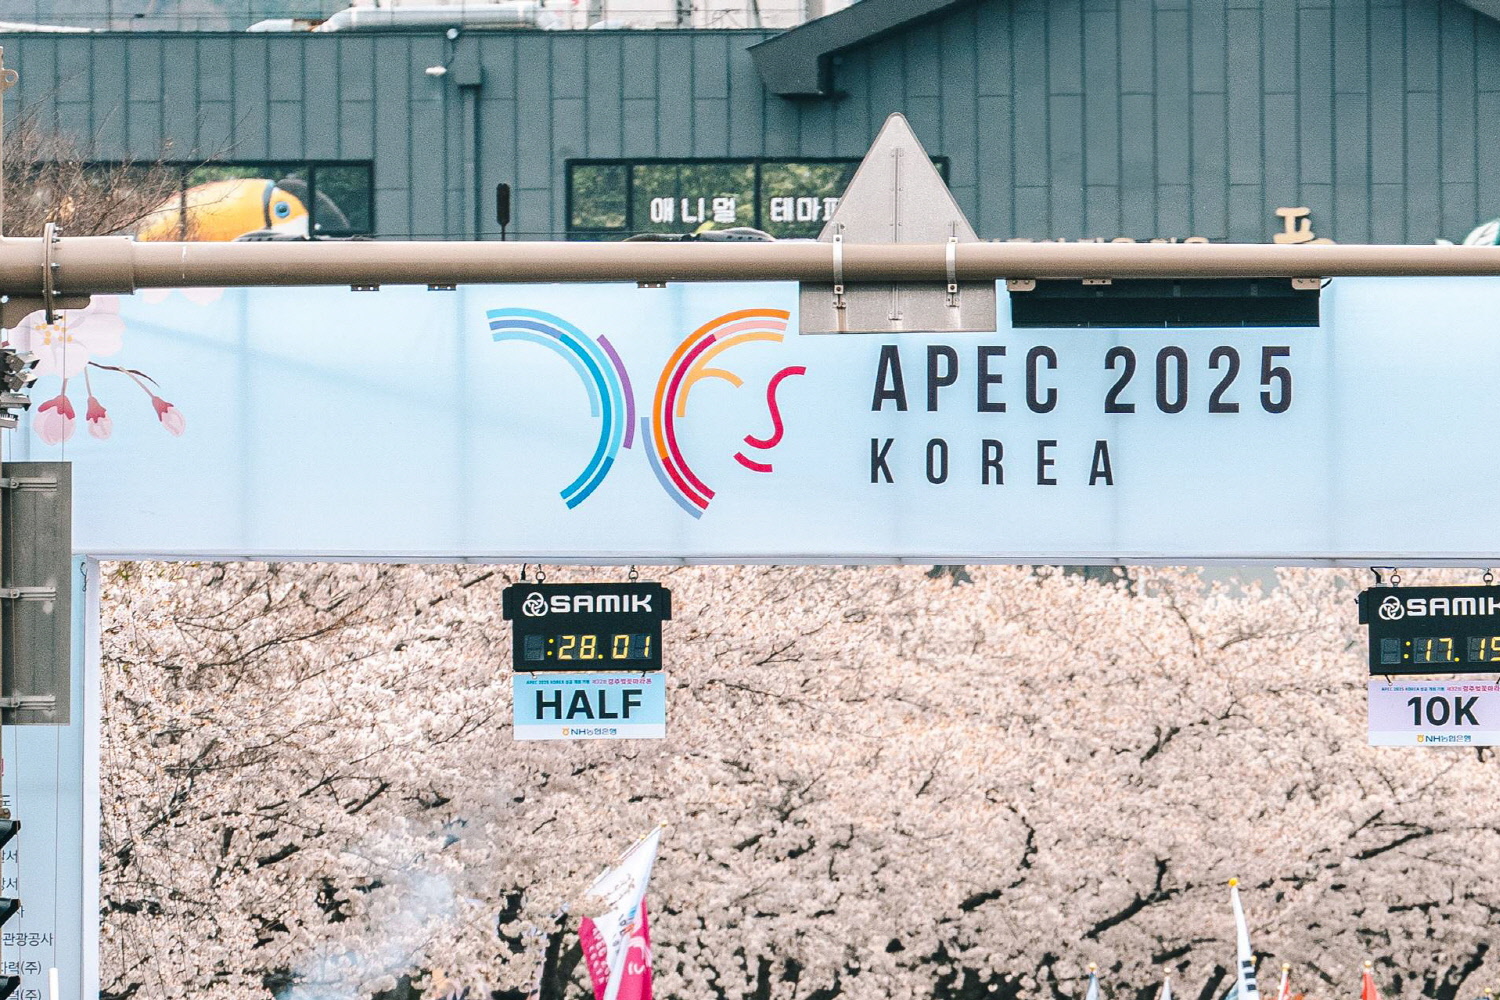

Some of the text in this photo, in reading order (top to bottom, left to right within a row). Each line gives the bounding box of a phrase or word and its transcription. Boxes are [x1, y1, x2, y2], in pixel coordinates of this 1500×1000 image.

[650, 197, 736, 223] 애니멀
[872, 345, 1292, 413] APEC 2025
[870, 438, 1114, 486] KOREA
[551, 594, 652, 613] SAMIK
[536, 689, 643, 719] HALF
[1407, 696, 1480, 726] 10K
[3, 932, 53, 946] 관광공사
